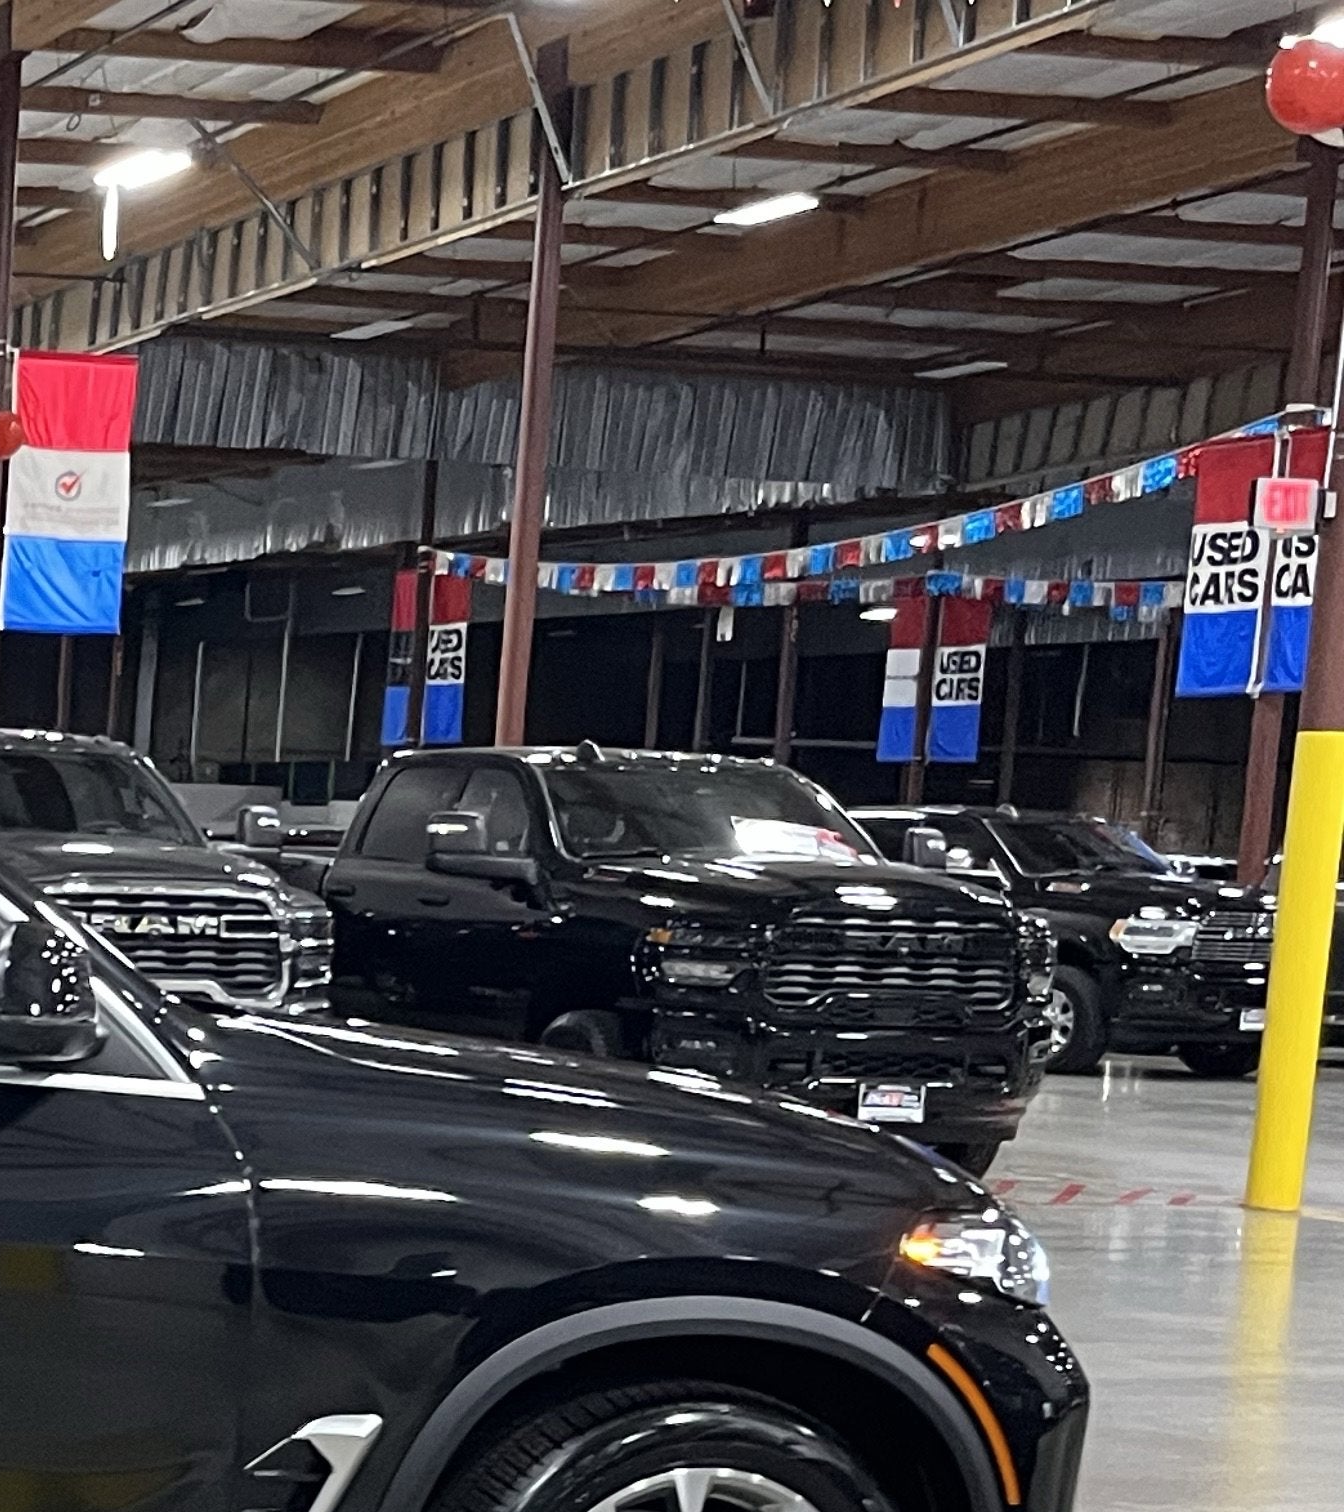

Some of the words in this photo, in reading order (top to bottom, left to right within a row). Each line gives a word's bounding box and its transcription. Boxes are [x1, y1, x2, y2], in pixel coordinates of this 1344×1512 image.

[1192, 529, 1260, 567] USED
[1189, 567, 1259, 606] CARS
[1275, 563, 1311, 599] CA
[939, 650, 982, 675] USED
[90, 912, 219, 936] RAM
